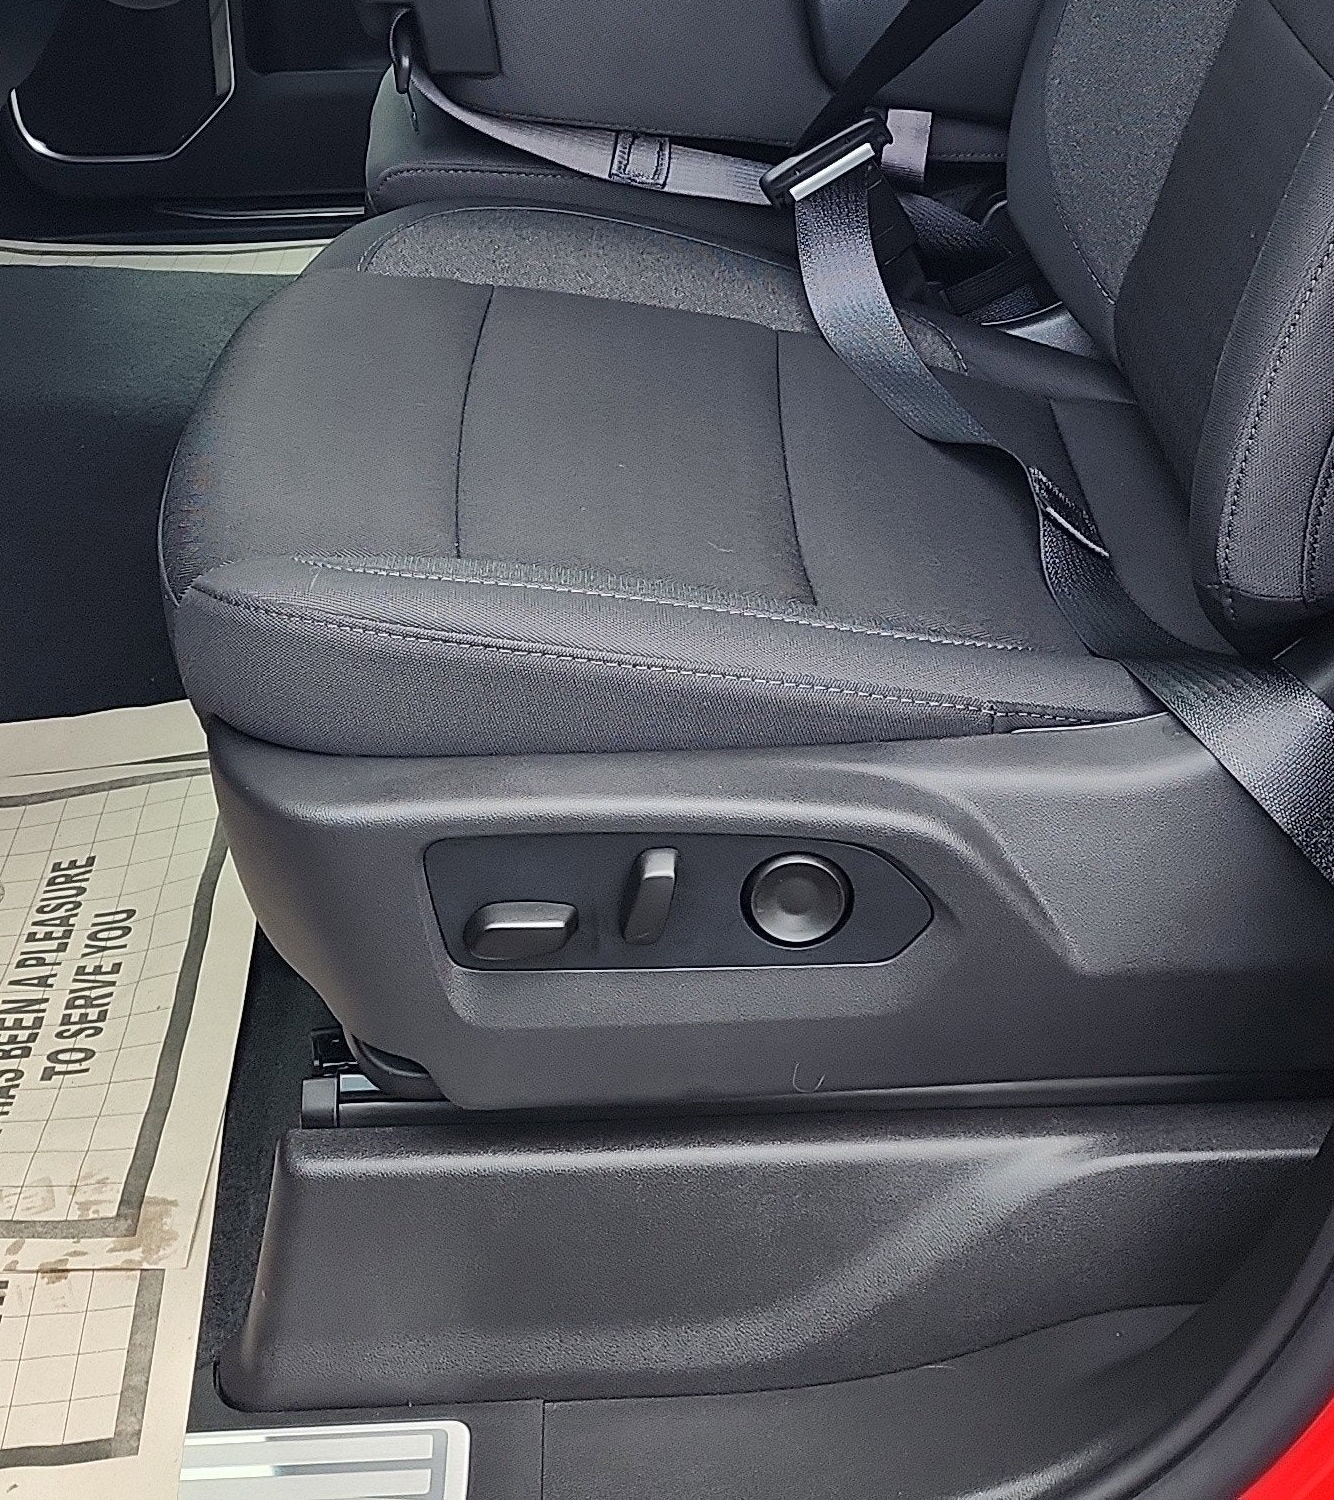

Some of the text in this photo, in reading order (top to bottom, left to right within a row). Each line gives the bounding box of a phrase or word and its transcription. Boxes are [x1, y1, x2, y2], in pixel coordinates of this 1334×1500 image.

[14, 855, 97, 970] PLEASURE
[7, 972, 58, 988] A
[39, 908, 137, 1082] TO SERVE YOU
